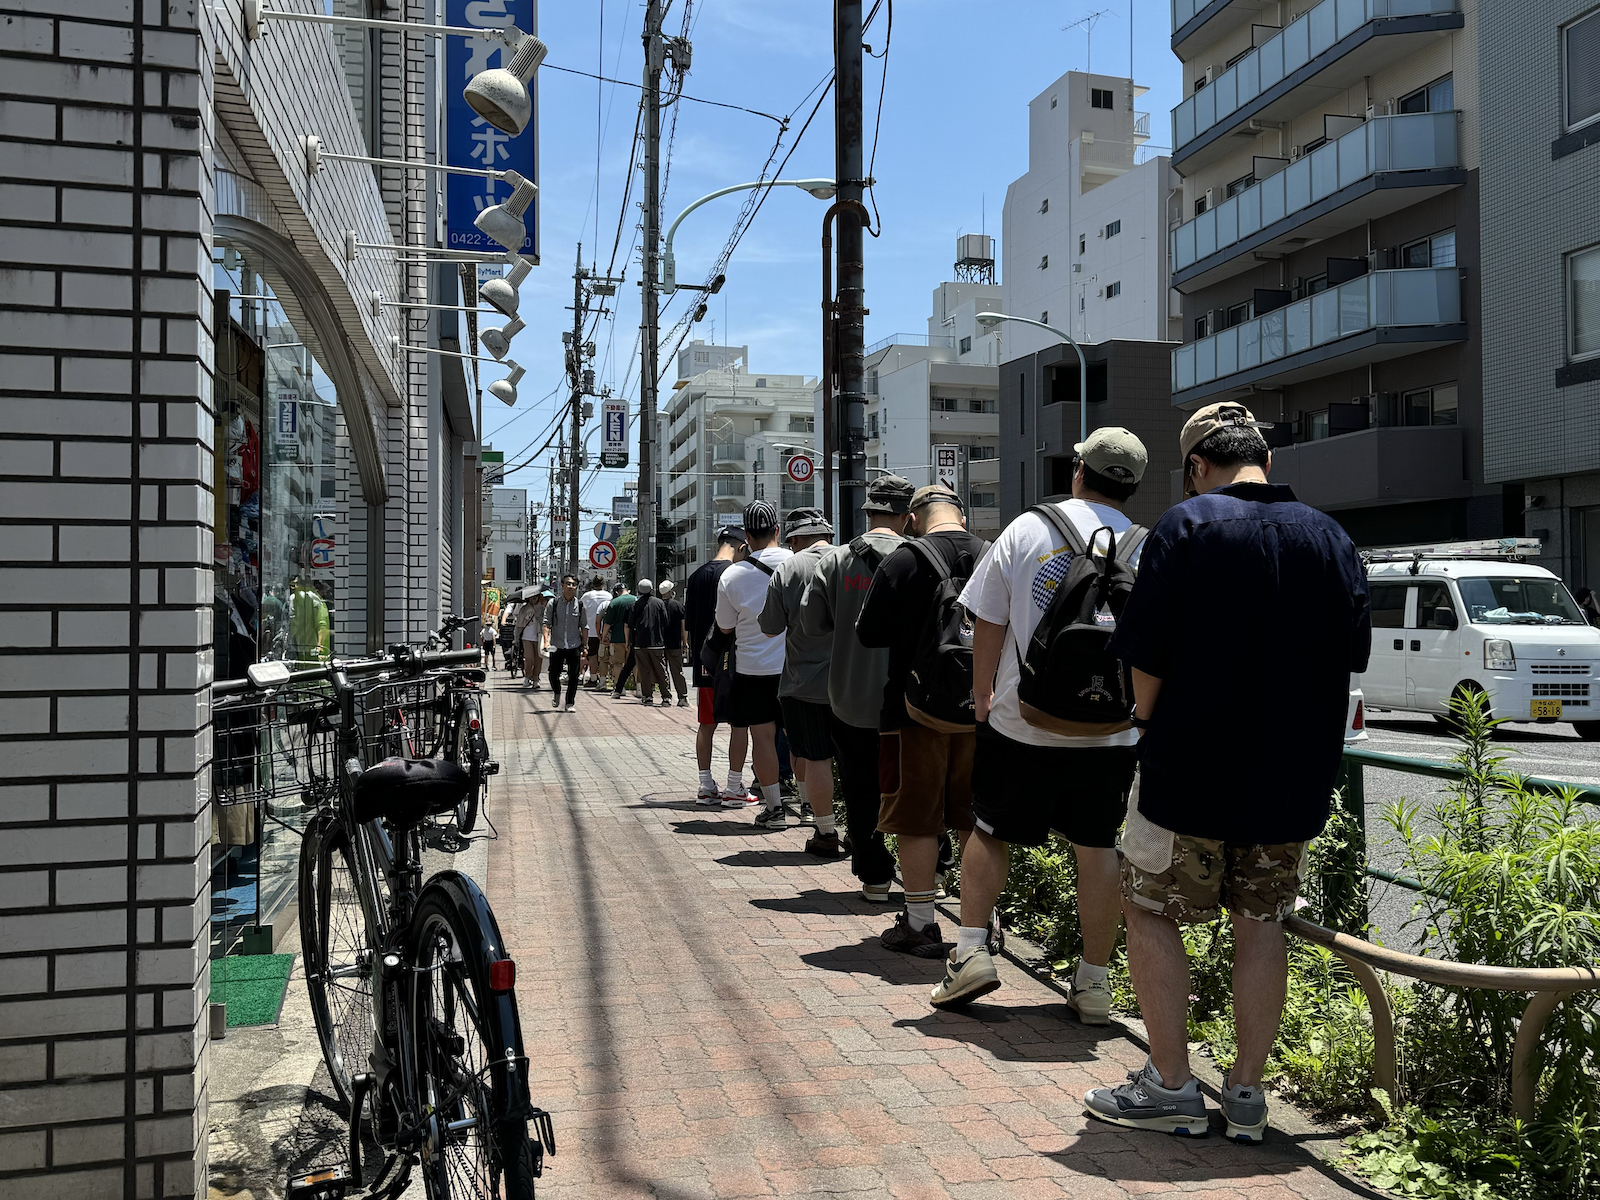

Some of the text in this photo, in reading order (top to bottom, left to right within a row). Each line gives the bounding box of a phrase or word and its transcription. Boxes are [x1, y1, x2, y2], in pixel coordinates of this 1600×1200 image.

[610, 412, 621, 441] KEN
[793, 462, 809, 475] 40
[939, 468, 954, 476] あり
